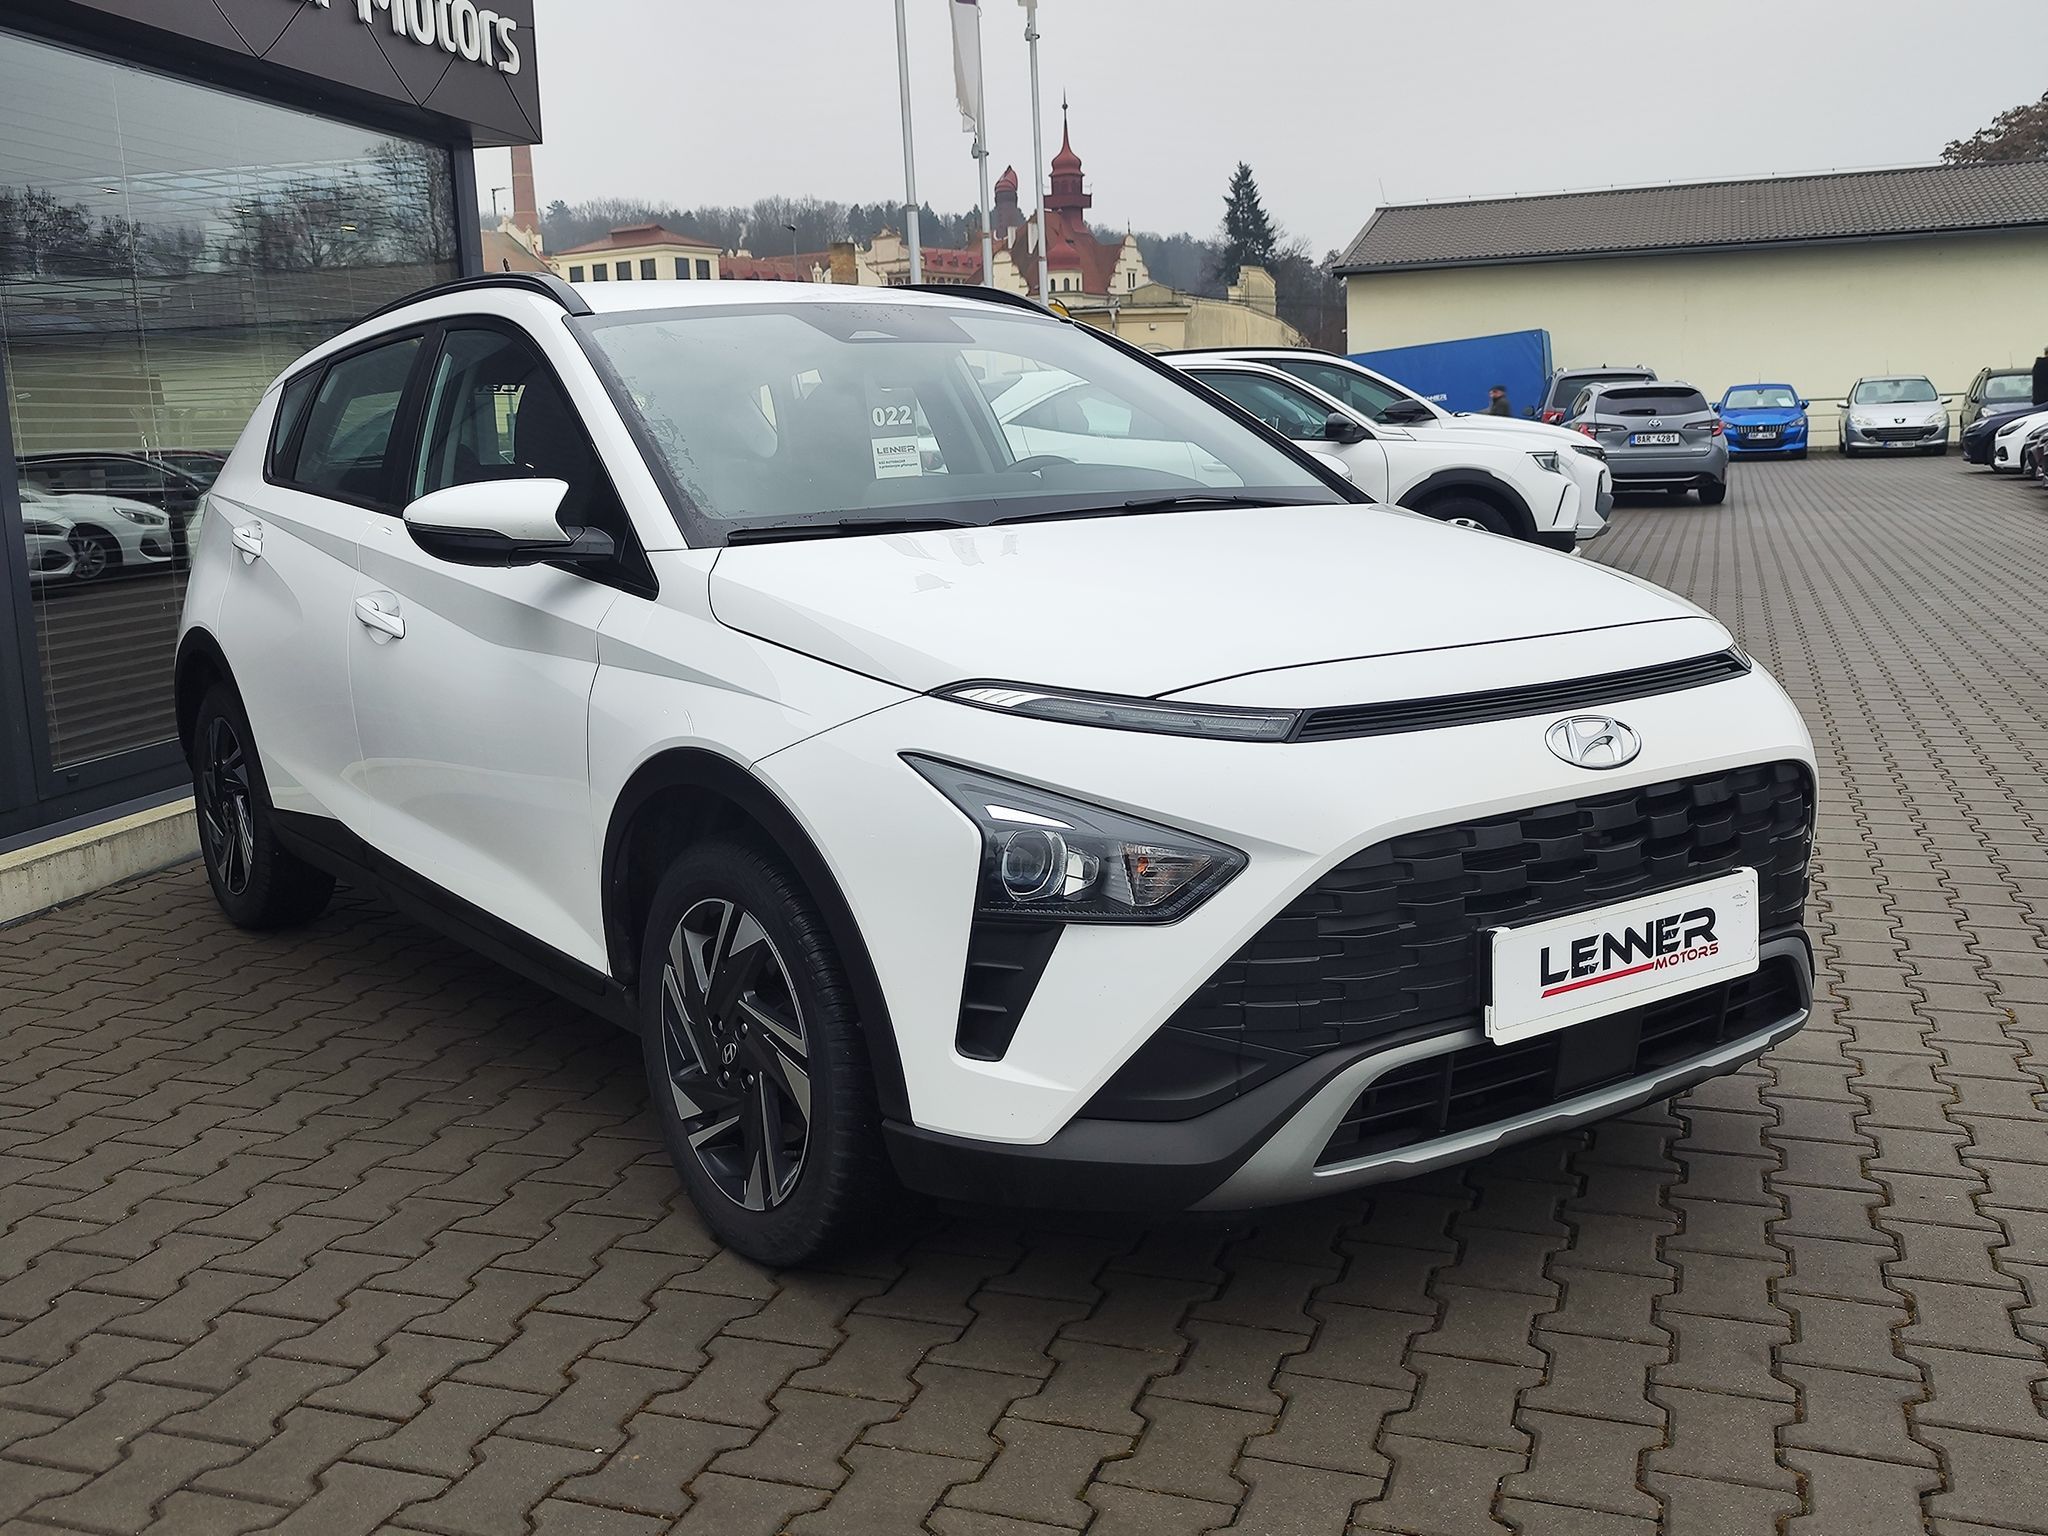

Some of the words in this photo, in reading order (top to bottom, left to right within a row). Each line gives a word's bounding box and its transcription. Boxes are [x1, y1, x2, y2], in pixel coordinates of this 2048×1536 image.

[872, 405, 913, 427] 022
[876, 445, 916, 455] LENNER
[1540, 907, 1719, 988] LENNER
[1654, 942, 1719, 971] MOTORS
